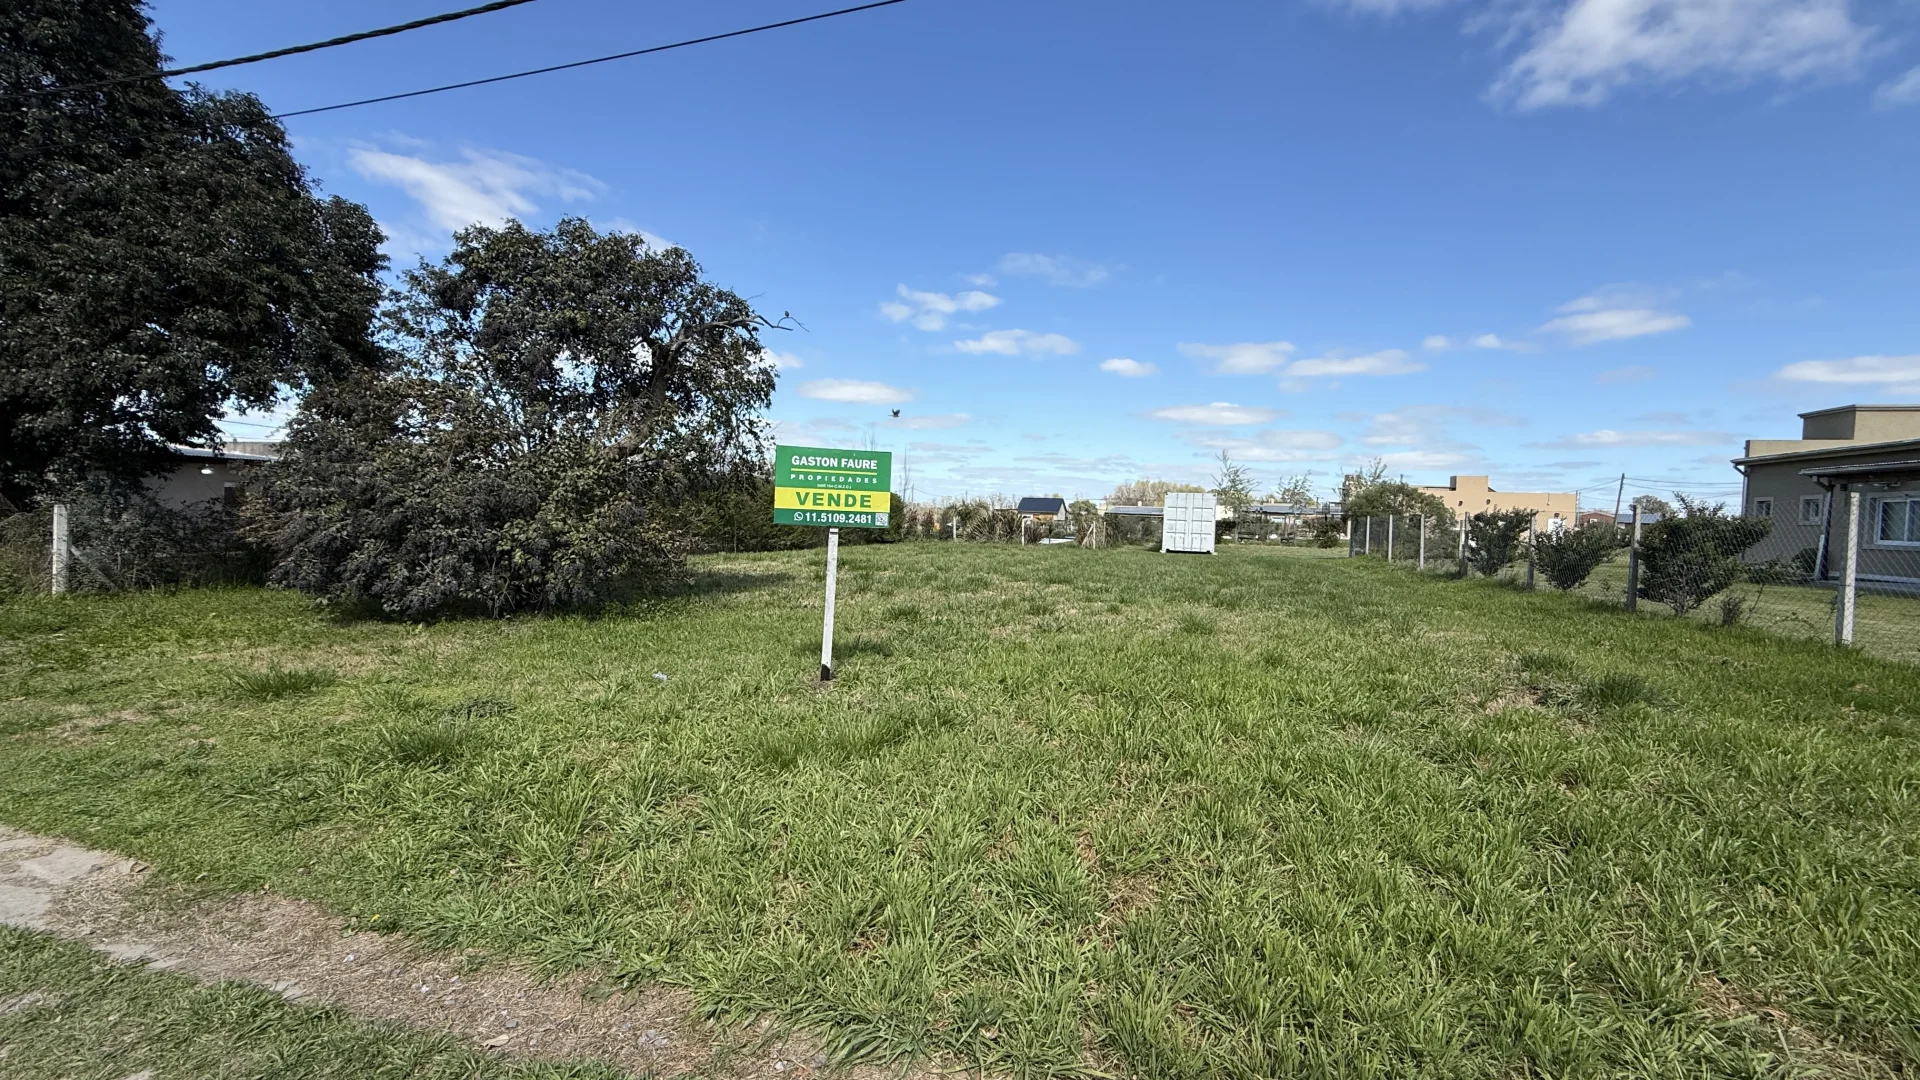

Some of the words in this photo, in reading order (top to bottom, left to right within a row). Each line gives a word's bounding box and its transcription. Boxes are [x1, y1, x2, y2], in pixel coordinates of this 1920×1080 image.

[791, 455, 838, 468] GASTON
[841, 458, 878, 469] FAURE
[790, 474, 878, 484] PROPIEDADES
[795, 491, 872, 508] VENDE
[805, 512, 872, 524] 11.5109.2481
